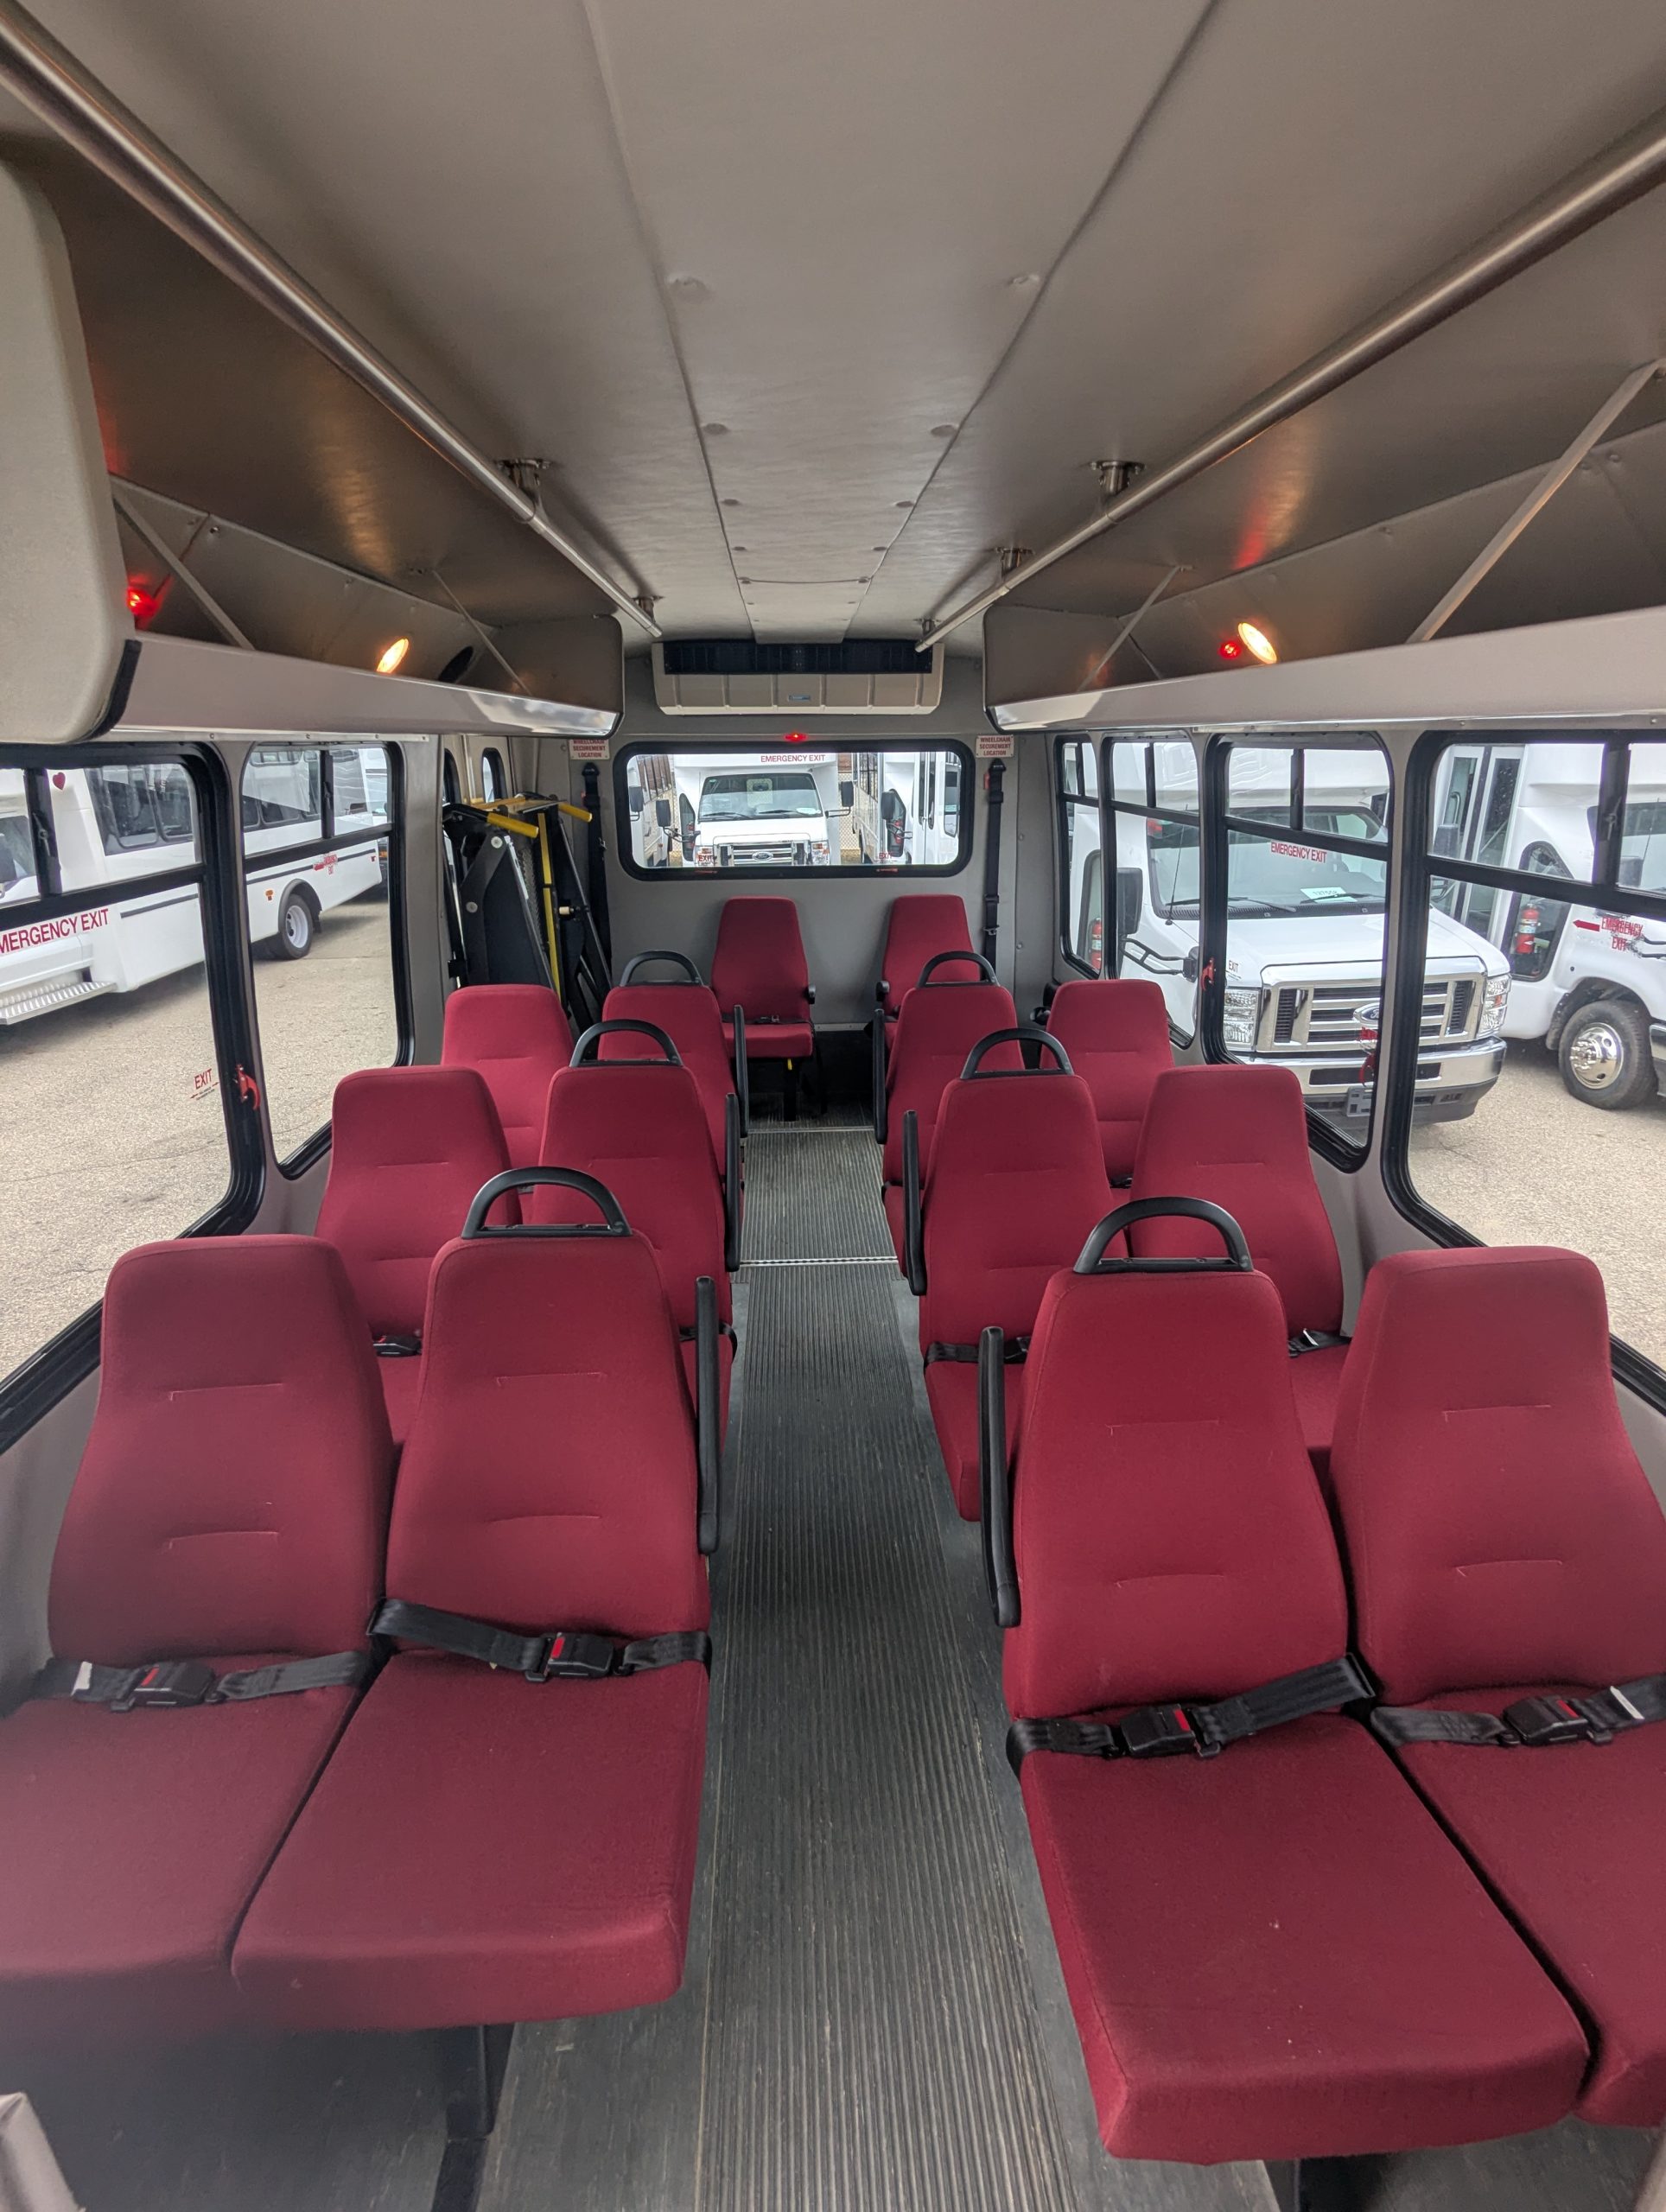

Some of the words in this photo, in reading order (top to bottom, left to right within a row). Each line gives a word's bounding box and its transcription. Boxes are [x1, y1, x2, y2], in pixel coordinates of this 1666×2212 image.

[760, 754, 808, 763] EMERGENCY
[1271, 842, 1311, 860] EMERGENCY
[1311, 849, 1327, 863] EXIT
[80, 908, 109, 931] EXIT
[1228, 959, 1239, 973] EXIT
[194, 1068, 212, 1090] EXIT
